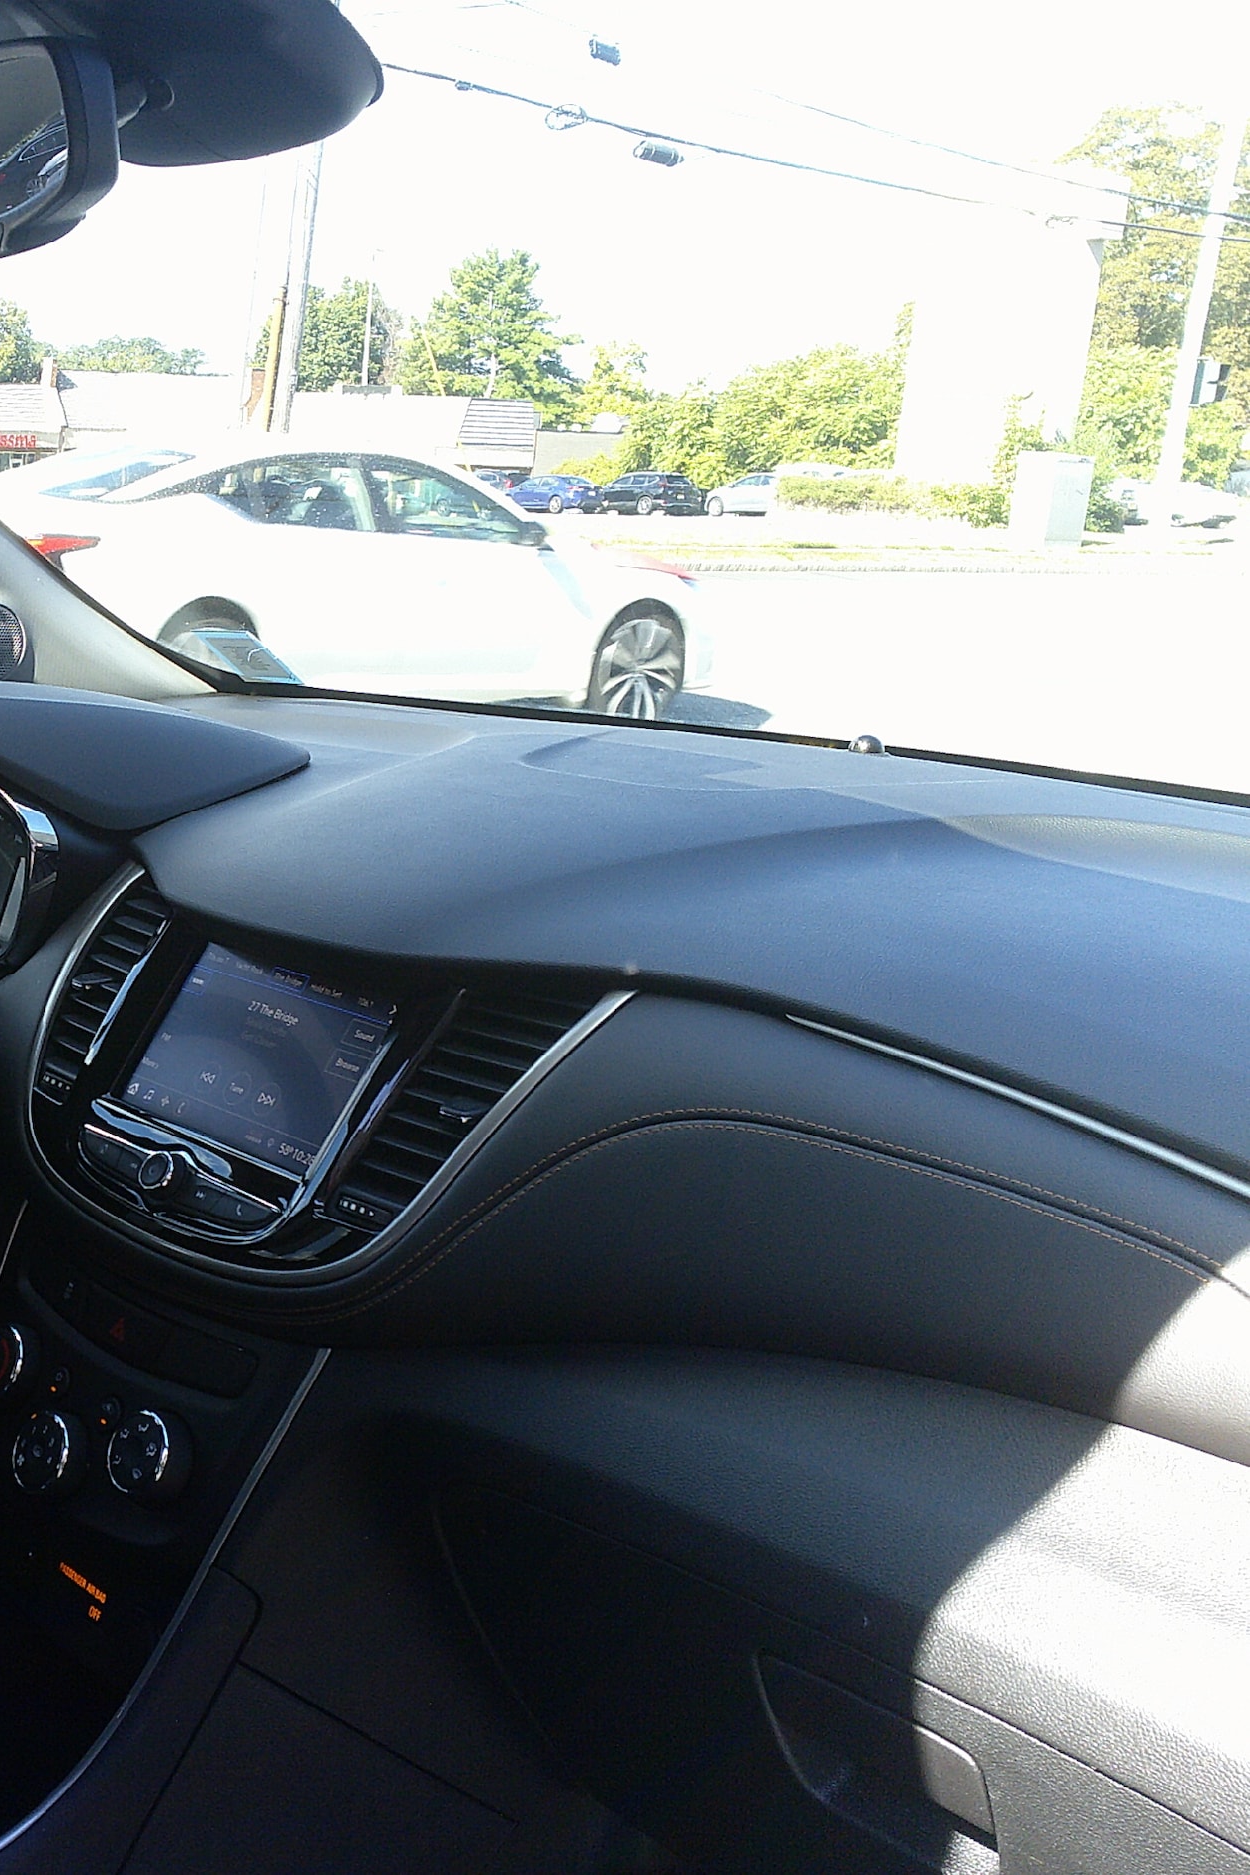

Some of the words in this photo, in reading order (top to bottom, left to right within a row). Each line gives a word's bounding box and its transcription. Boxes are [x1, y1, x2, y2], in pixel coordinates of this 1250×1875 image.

[248, 1000, 260, 1012] 27
[260, 1003, 274, 1019] The
[274, 1007, 299, 1026] Bridge
[354, 1028, 376, 1043] Sound
[335, 1057, 360, 1073] Browse
[229, 1081, 243, 1095] Tune
[59, 1561, 87, 1589] PASSENGER
[86, 1583, 107, 1604] AIRBAG
[88, 1605, 102, 1622] OFF
